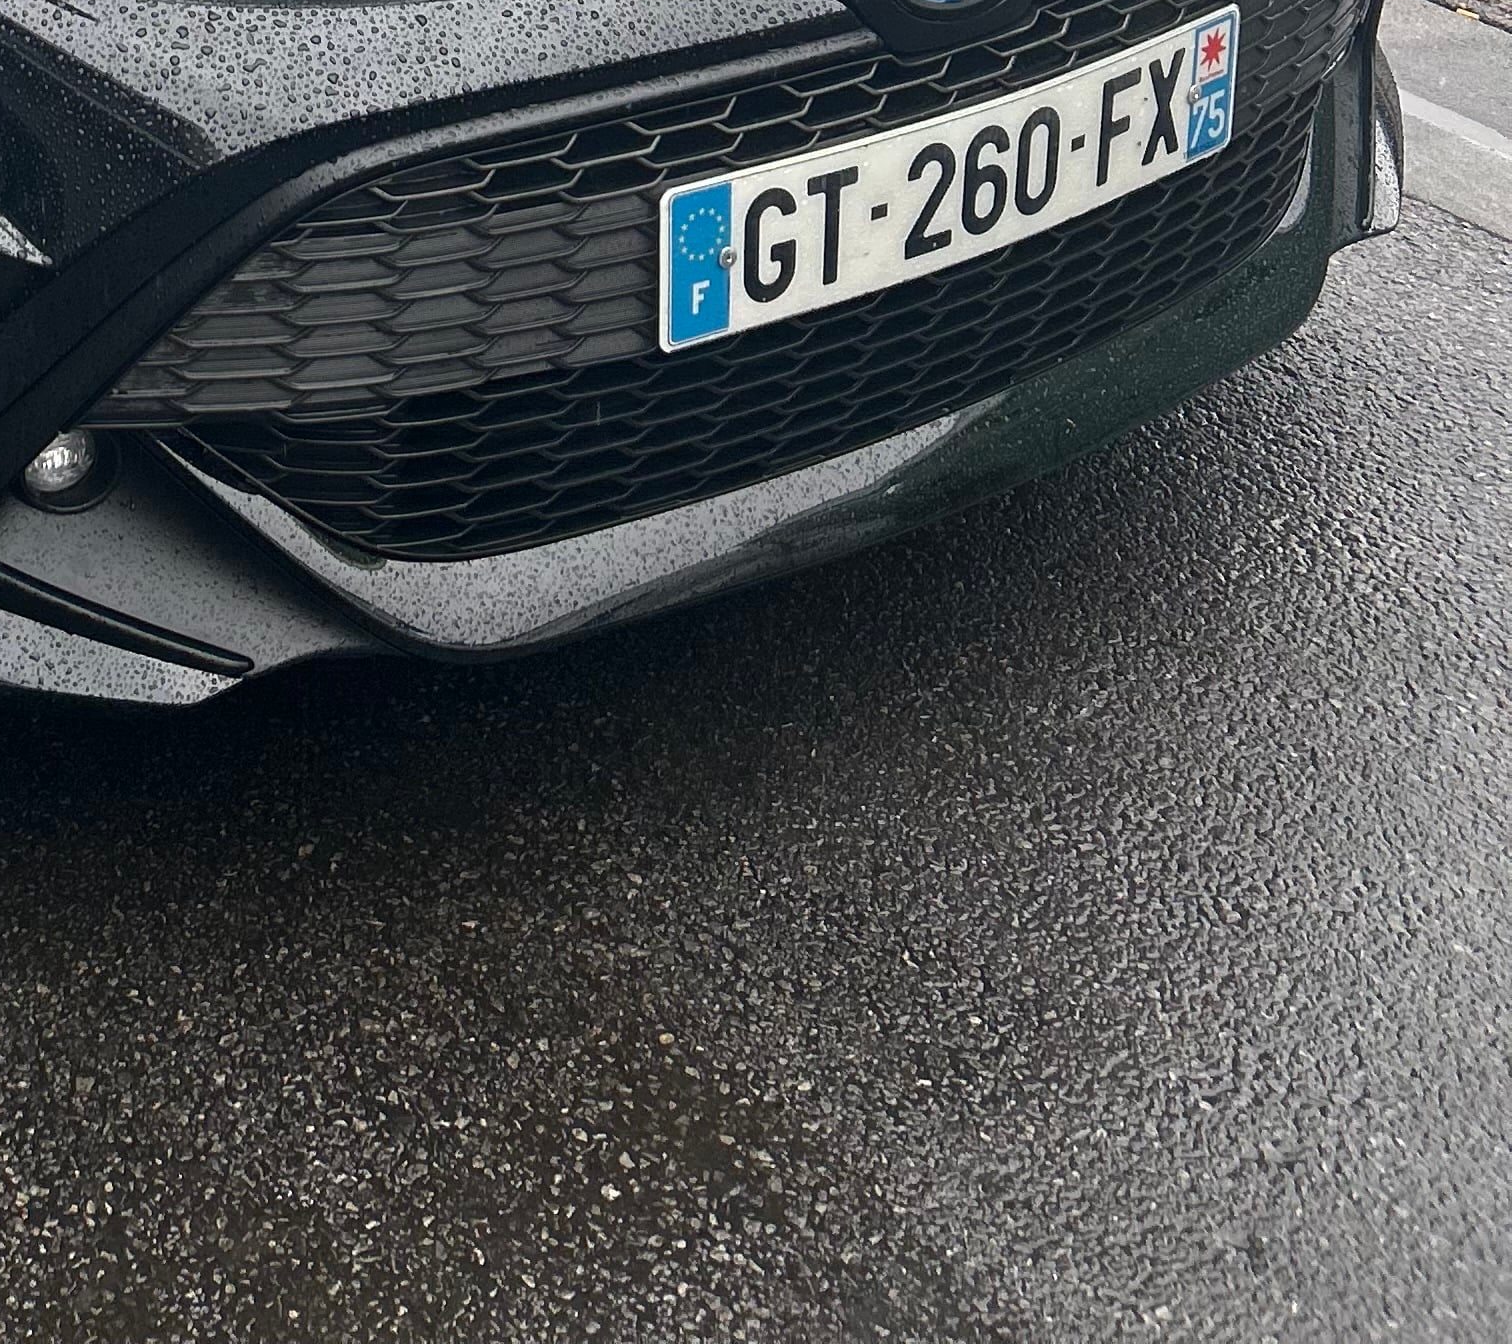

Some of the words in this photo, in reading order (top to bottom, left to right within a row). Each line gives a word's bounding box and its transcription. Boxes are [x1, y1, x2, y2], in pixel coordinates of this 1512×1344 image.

[1190, 89, 1225, 150] 75
[743, 48, 1185, 303] GT-260-FX
[692, 279, 710, 316] F
